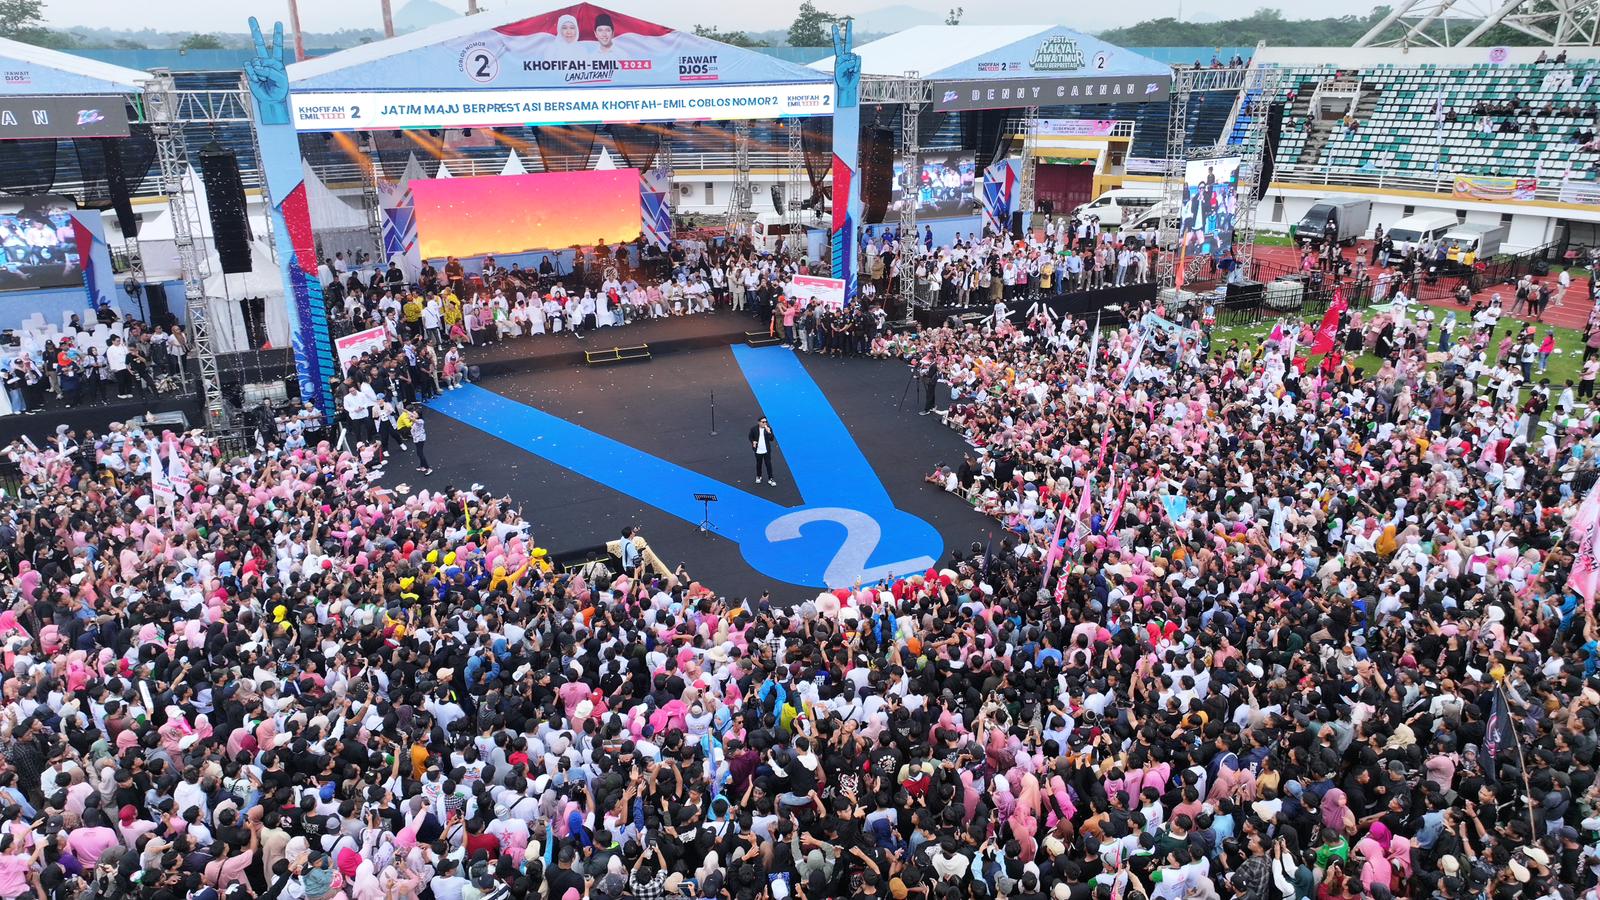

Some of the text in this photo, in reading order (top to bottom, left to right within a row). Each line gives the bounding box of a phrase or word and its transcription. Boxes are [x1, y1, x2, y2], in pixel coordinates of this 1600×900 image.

[1040, 40, 1077, 54] RAKYAT
[682, 55, 718, 64] FAWAIT
[1030, 50, 1057, 66] JAWA
[1057, 49, 1085, 66] TIMUR
[1097, 56, 1105, 69] 2
[474, 54, 491, 78] 2
[523, 60, 650, 71] KHOFIFAH-EMIL 2024
[679, 64, 708, 75] DJOS
[1001, 62, 1007, 71] 2
[564, 70, 614, 81] LANJUTKAN!!
[971, 87, 1040, 101] DENNY
[1056, 83, 1135, 97] CAKNAN
[381, 104, 421, 115] JATIM
[424, 104, 459, 114] MAJU
[544, 101, 599, 111] BERSAMA
[601, 99, 687, 111] KHOFIFAH-EMIL
[689, 98, 732, 108] COBLOS
[732, 97, 771, 107] NOMOR
[772, 96, 779, 105] 2
[823, 95, 831, 106] 2
[350, 105, 361, 119] 2
[765, 507, 937, 590] 2
